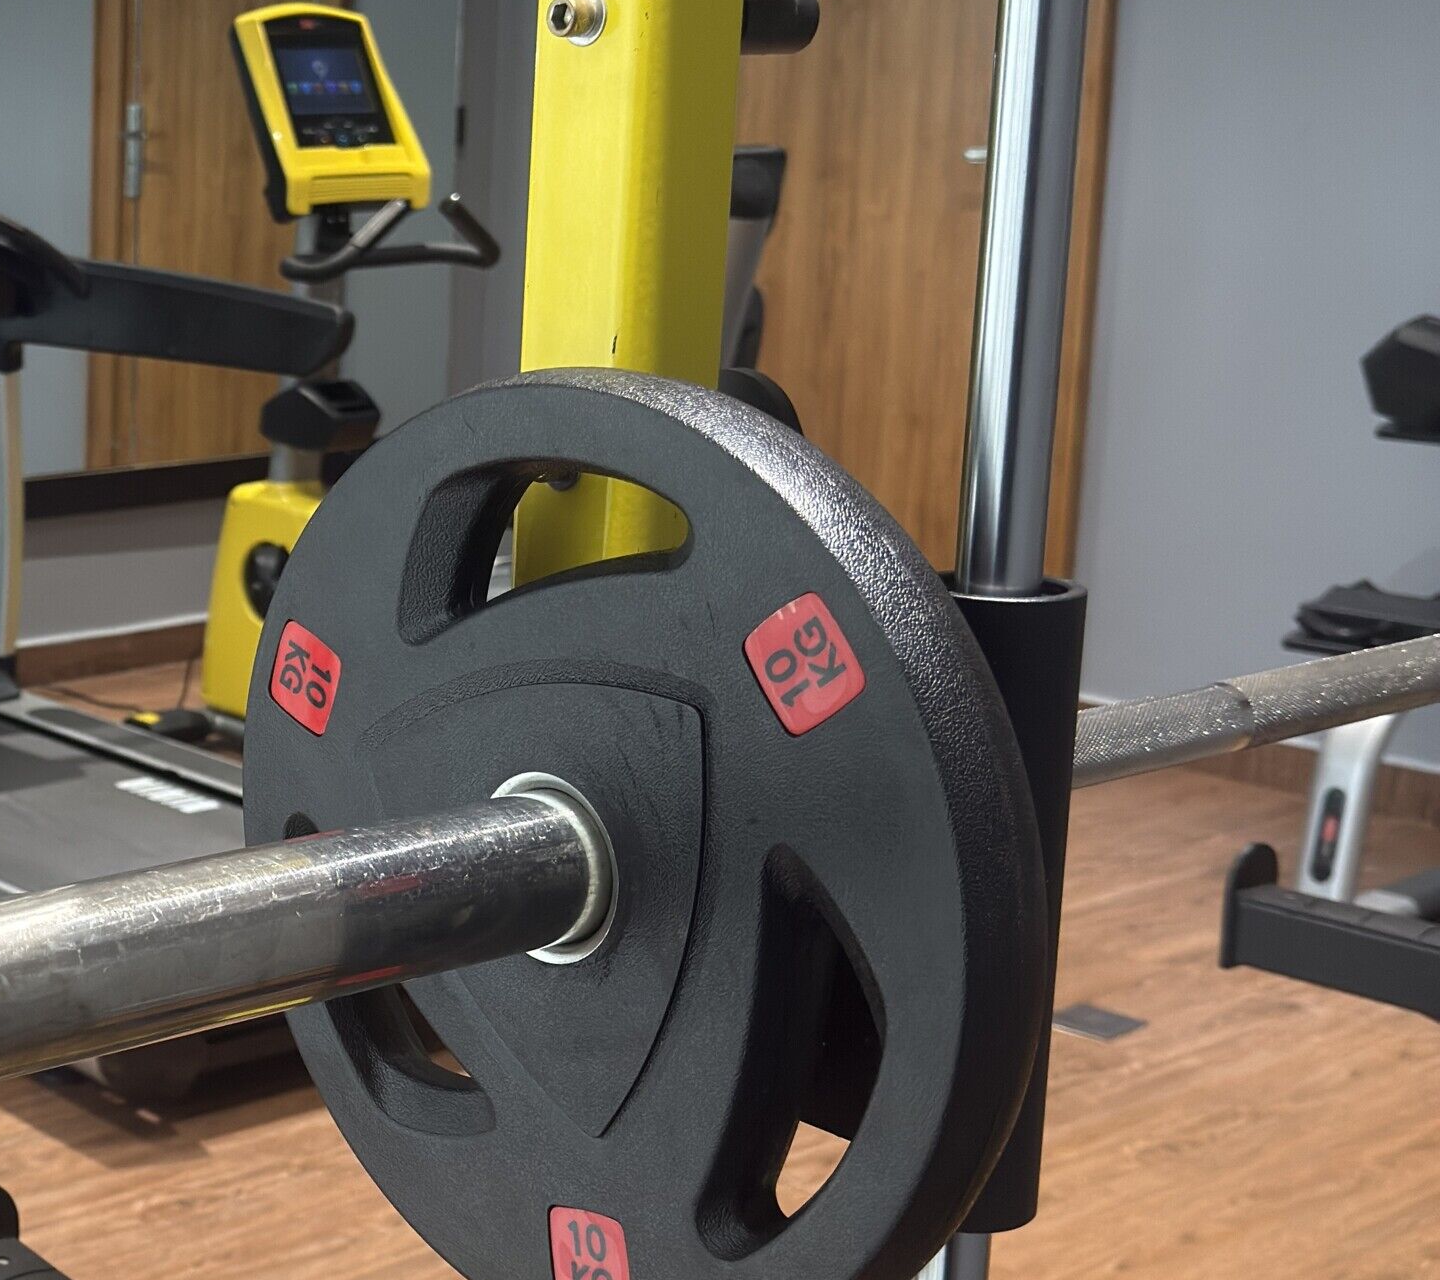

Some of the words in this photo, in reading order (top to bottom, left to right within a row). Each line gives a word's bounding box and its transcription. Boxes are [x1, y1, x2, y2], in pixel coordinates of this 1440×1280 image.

[280, 640, 310, 694] KG
[765, 649, 810, 707] 10
[794, 616, 847, 688] KG
[306, 664, 331, 709] 10
[568, 1220, 606, 1263] 10
